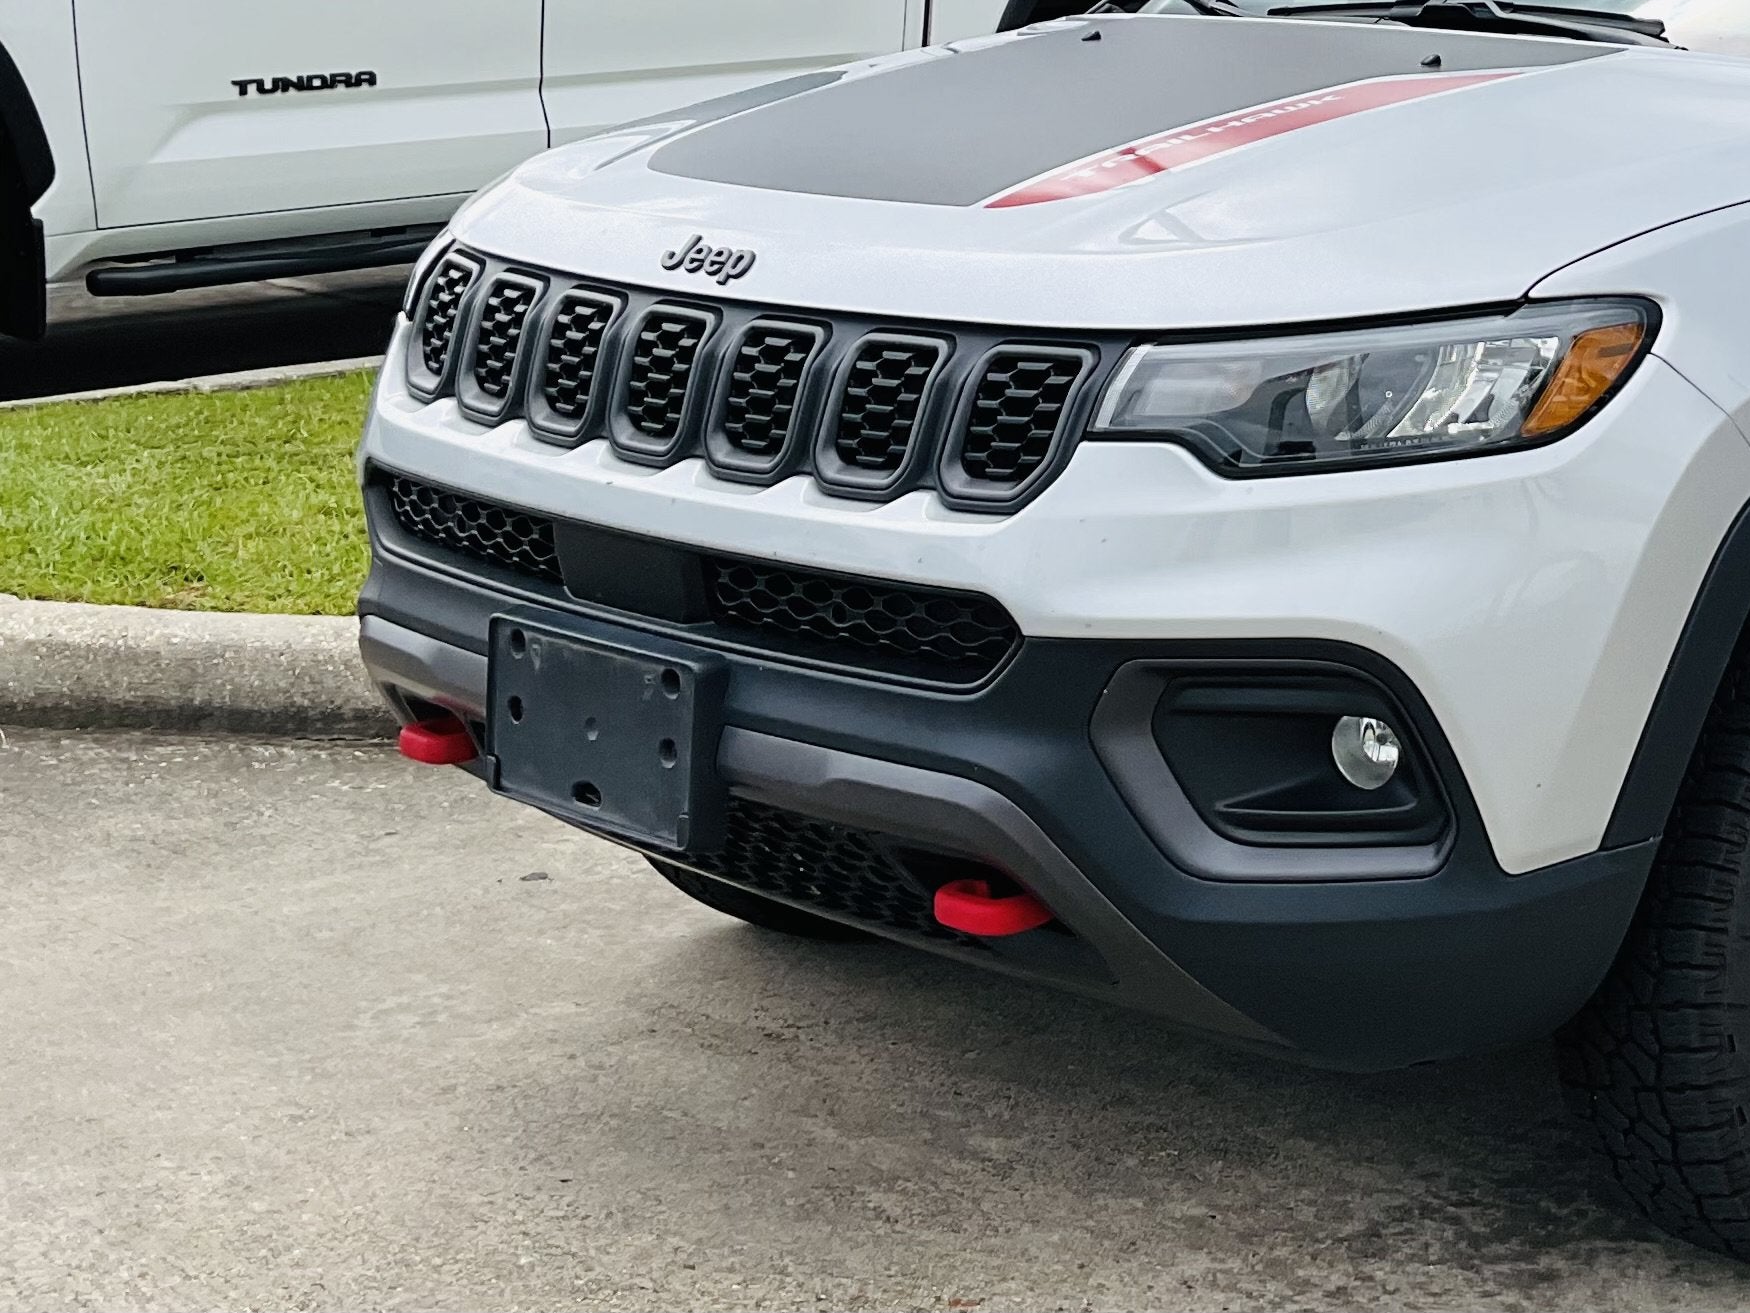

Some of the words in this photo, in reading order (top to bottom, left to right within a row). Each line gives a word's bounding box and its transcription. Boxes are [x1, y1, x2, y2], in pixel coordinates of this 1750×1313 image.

[231, 71, 377, 96] TUNDRA
[1060, 94, 1344, 180] TRAILHAWK
[660, 234, 756, 285] Jeep
